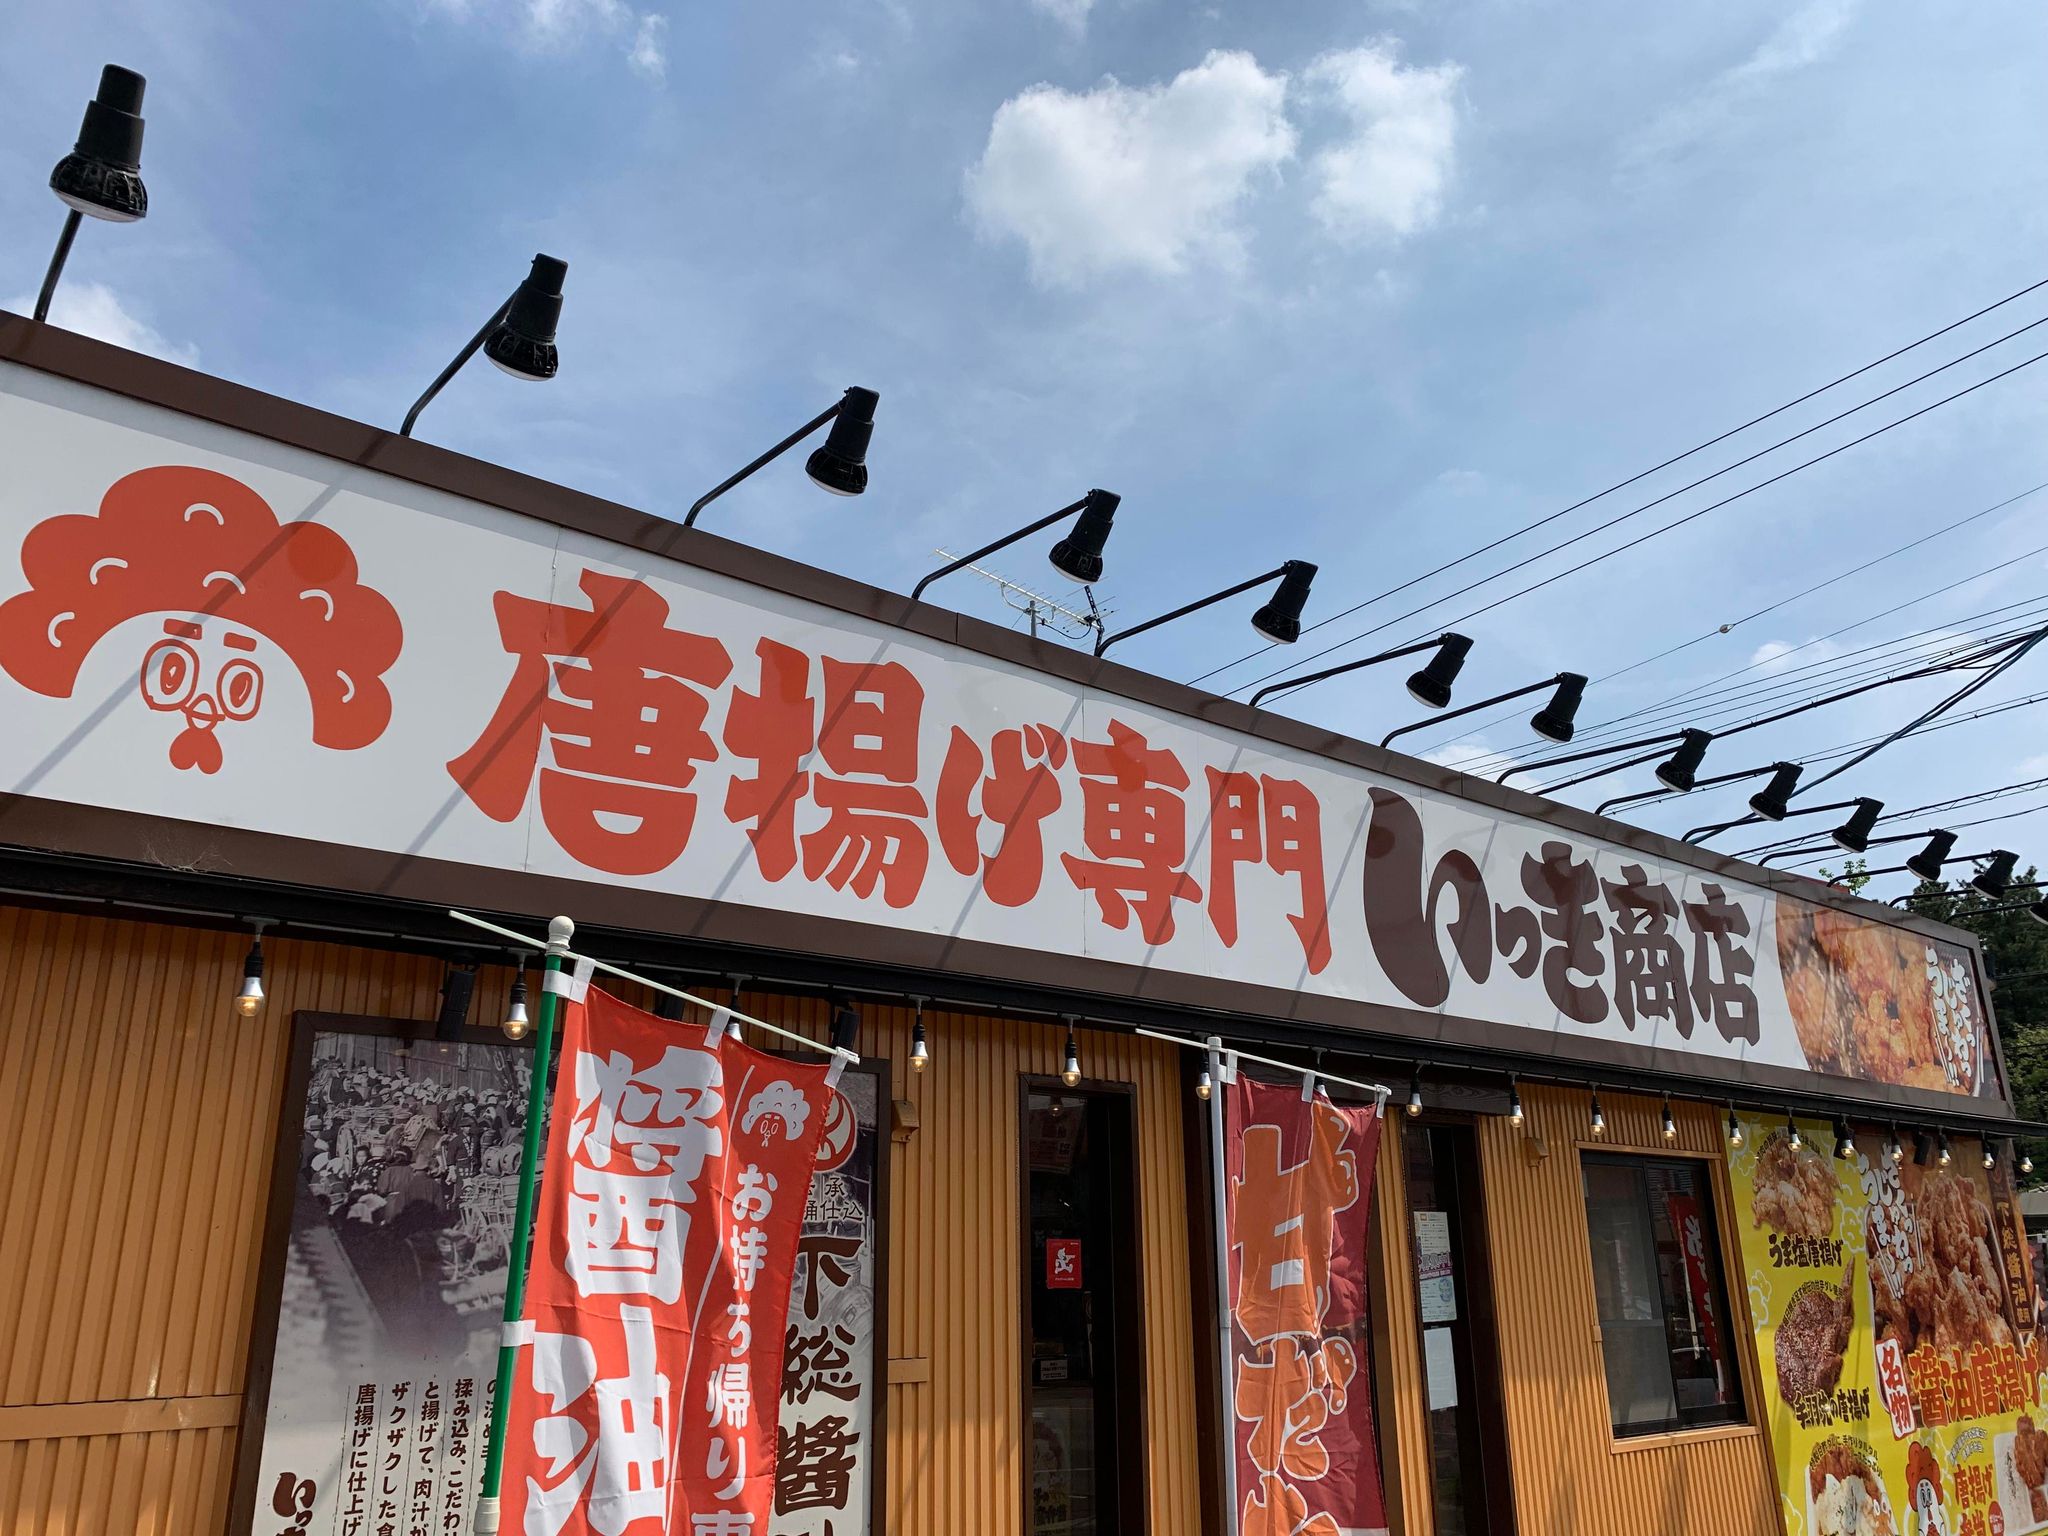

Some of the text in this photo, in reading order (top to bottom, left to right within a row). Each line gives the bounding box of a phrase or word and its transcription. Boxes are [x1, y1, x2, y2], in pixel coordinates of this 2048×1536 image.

[446, 568, 1760, 1047] 唐揚げ専門 いっき商店
[807, 1177, 846, 1198] 承
[1768, 1233, 1844, 1268] うま塩唐揚げ
[1881, 1344, 1913, 1435] 名物
[1907, 1336, 2040, 1429] 醤油唐揚げ
[342, 1383, 377, 1536] 唐揚げに仕上げ
[1953, 1463, 1993, 1510] 唐揚げ
[272, 1471, 317, 1536] いっ
